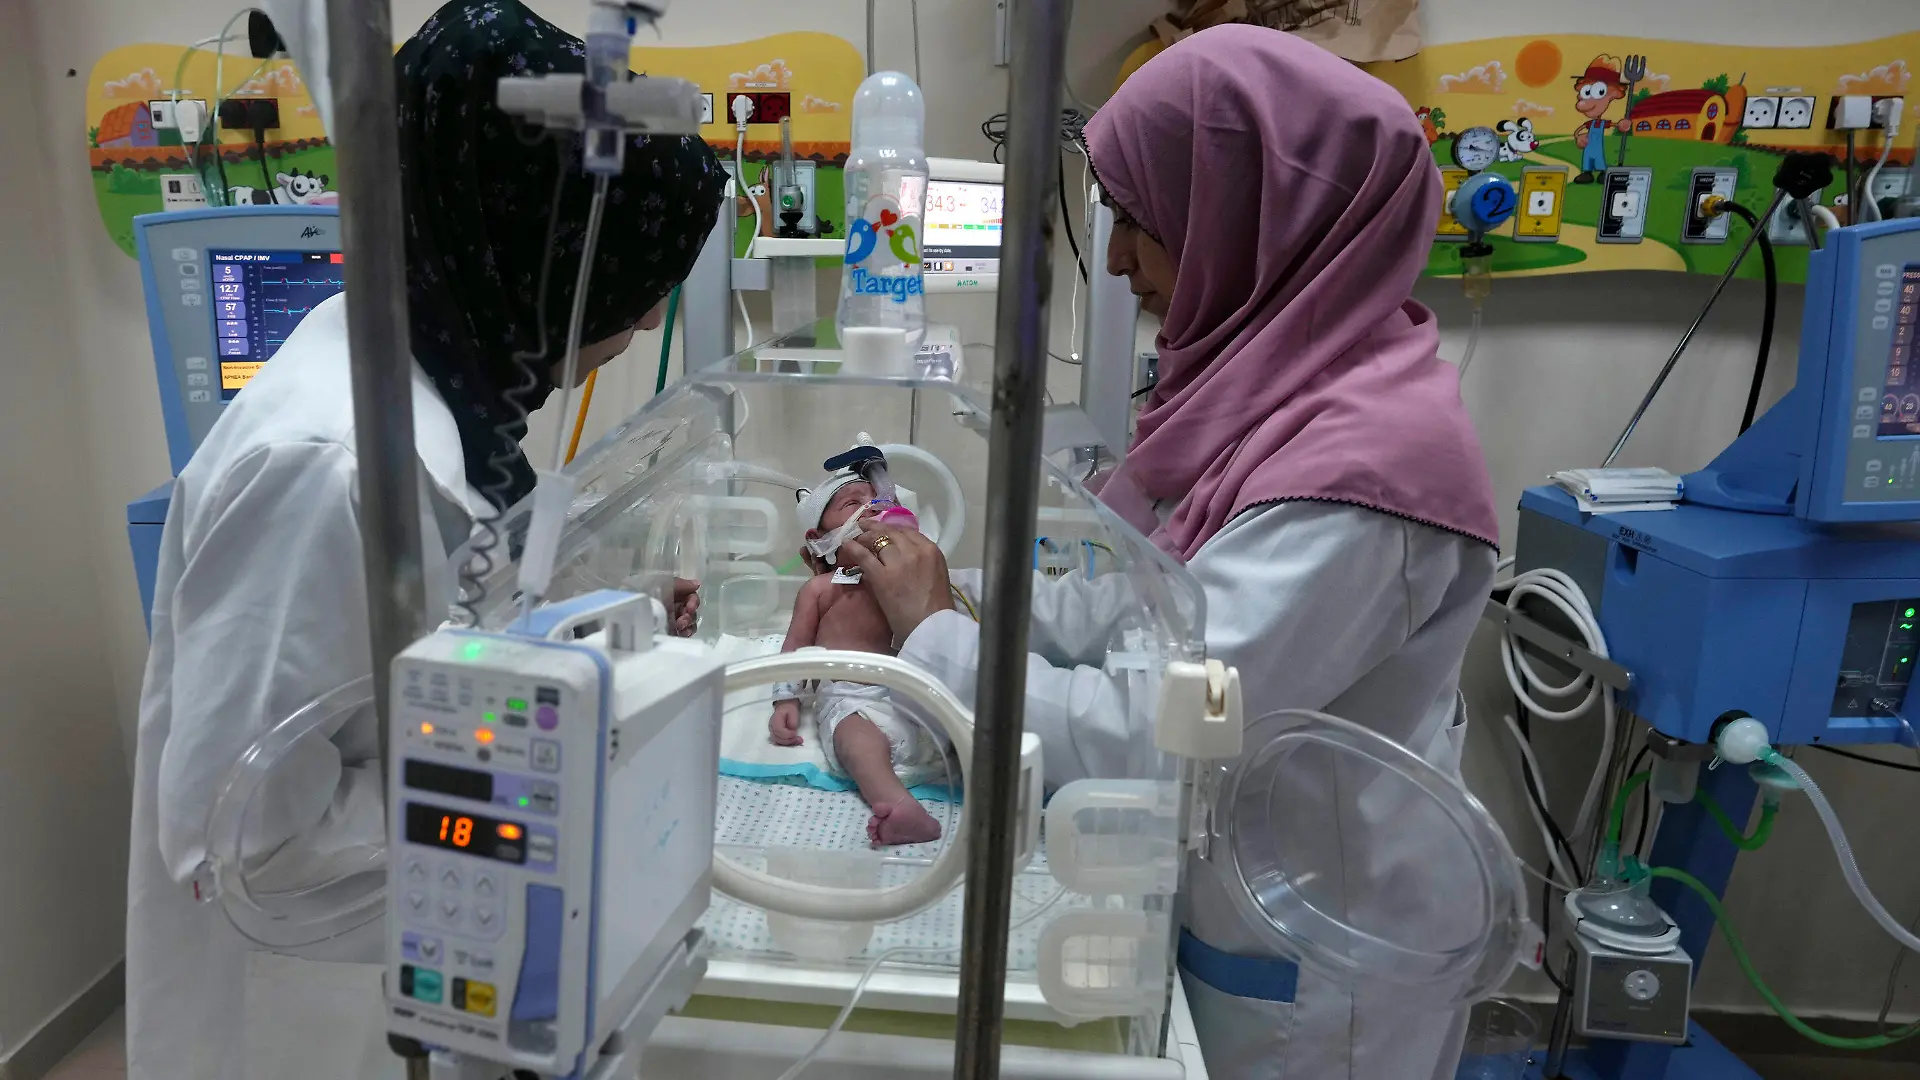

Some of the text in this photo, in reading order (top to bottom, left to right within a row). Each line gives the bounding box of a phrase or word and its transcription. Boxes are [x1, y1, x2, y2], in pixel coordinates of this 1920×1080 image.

[1483, 187, 1514, 218] 2
[225, 266, 231, 274] 5
[219, 284, 239, 293] 12.7
[852, 268, 923, 303] Target
[225, 303, 237, 311] 57
[439, 815, 474, 847] 18
